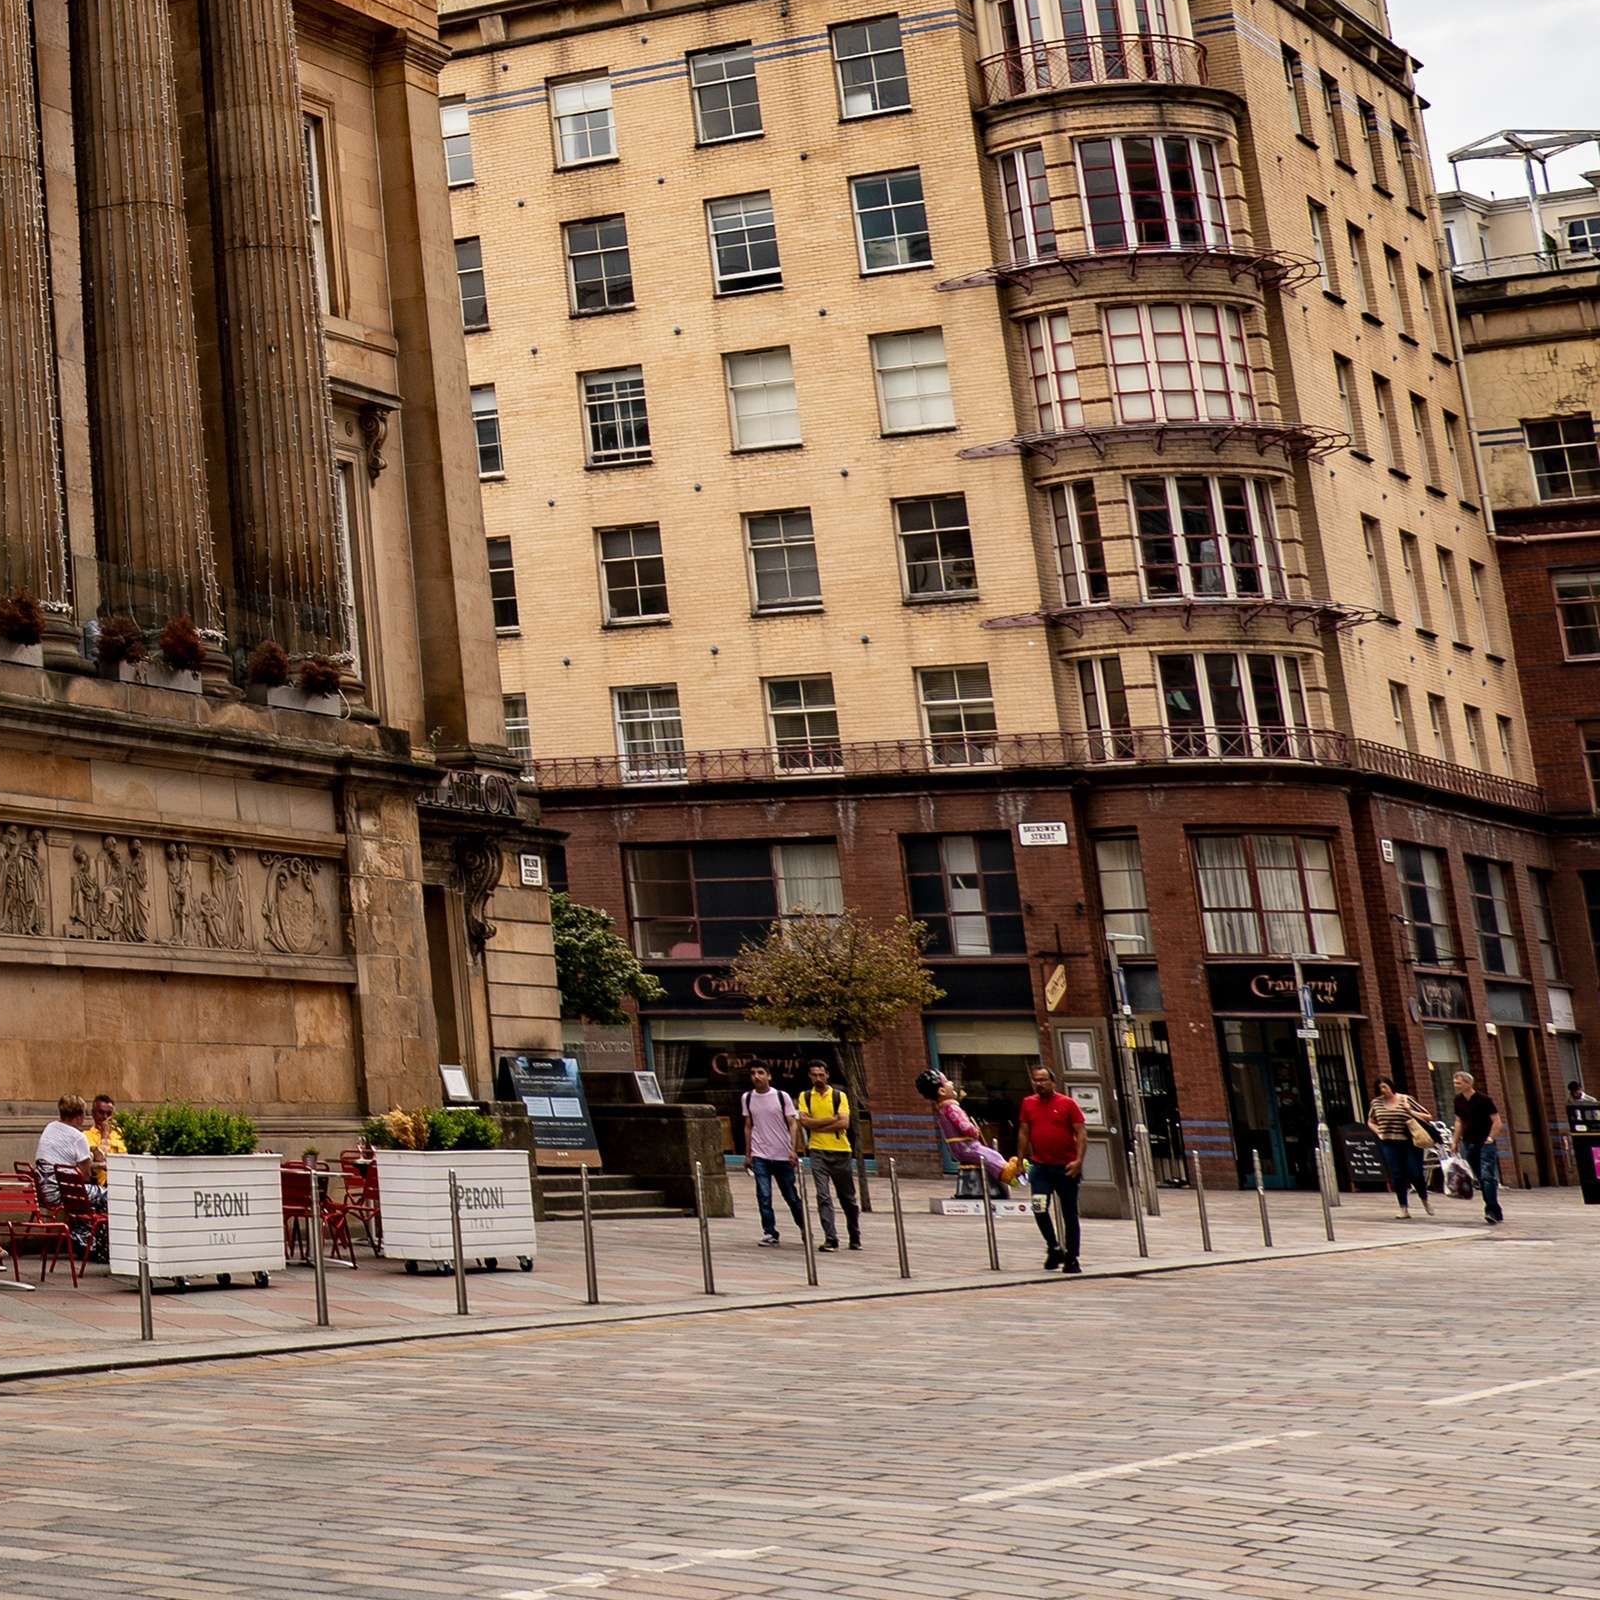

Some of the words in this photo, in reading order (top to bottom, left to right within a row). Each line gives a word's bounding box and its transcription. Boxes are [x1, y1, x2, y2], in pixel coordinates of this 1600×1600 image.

[193, 1191, 250, 1218] PERONI
[455, 1184, 505, 1210] PERONI
[208, 1232, 237, 1246] ITALY
